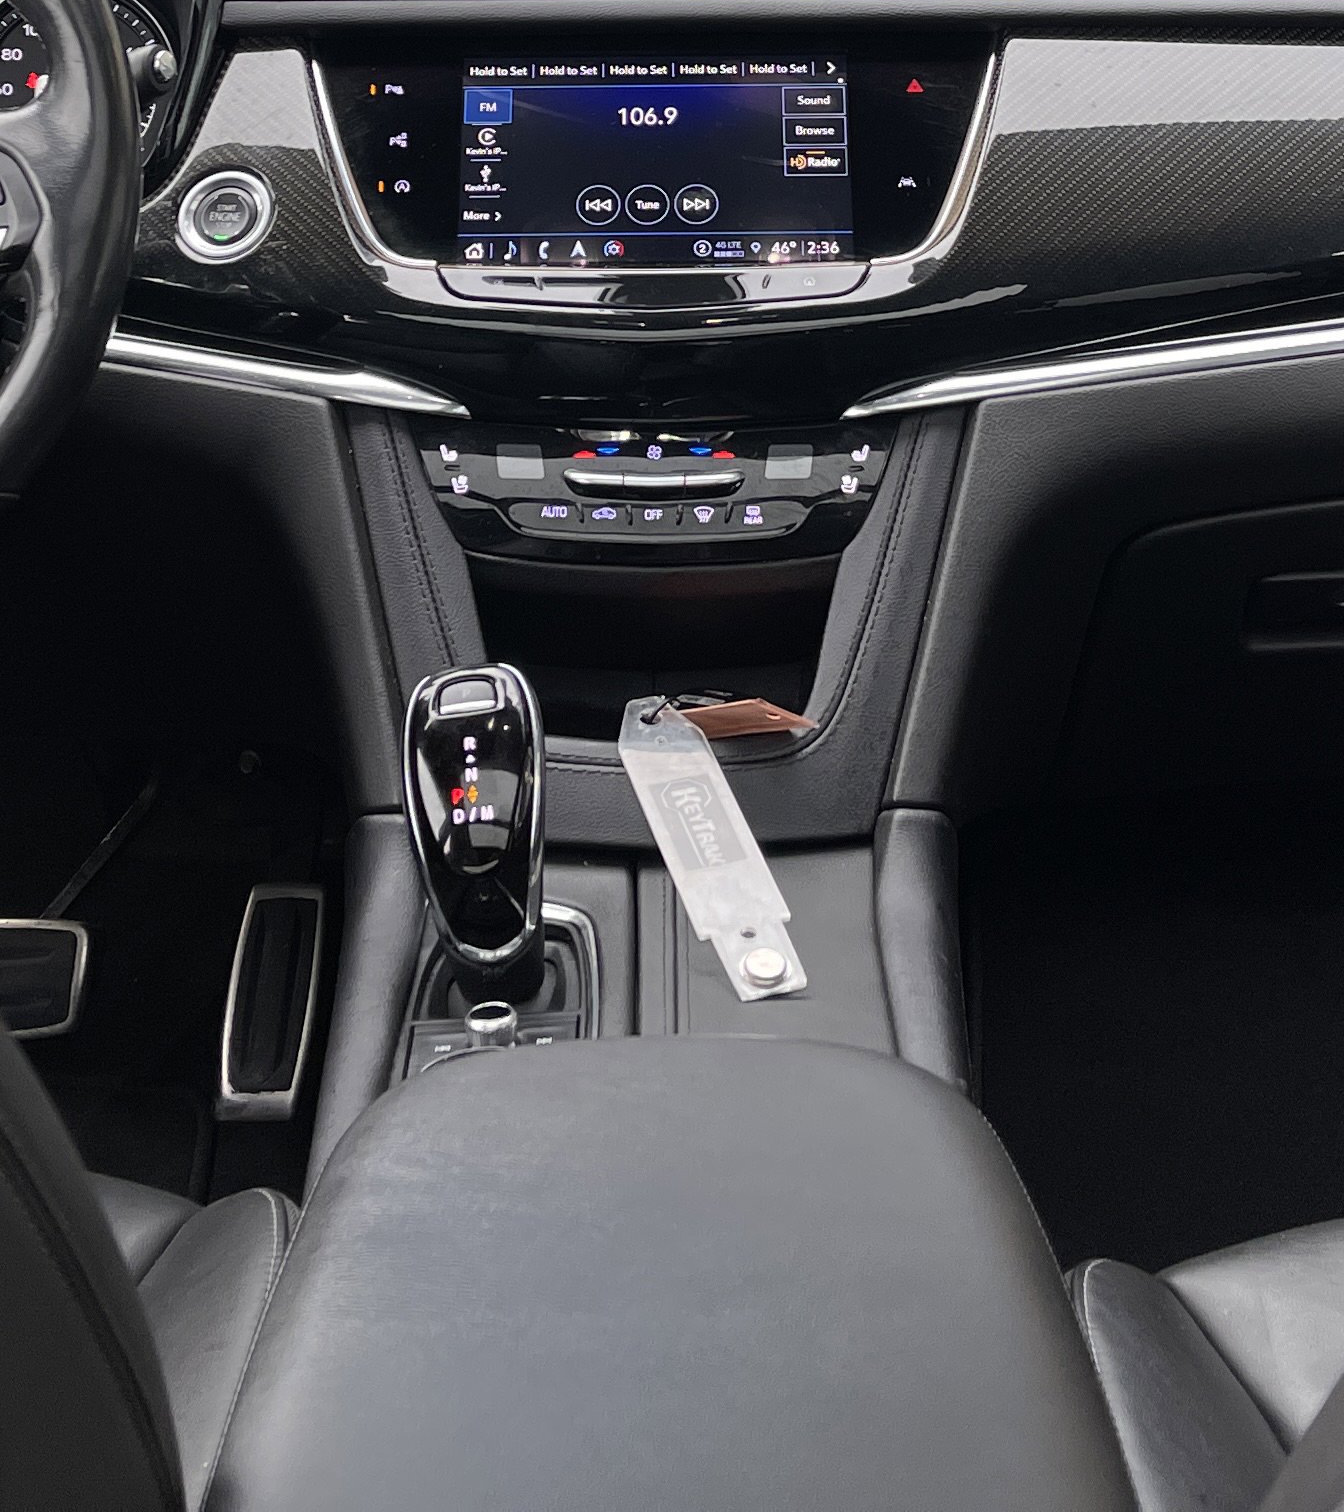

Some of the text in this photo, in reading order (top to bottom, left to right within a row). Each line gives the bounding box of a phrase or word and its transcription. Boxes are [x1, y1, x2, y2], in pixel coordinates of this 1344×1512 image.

[0, 48, 23, 62] 80
[469, 65, 528, 77] Hold to Set
[540, 64, 598, 76] Hold to Set
[609, 64, 668, 75] Hold to Set
[679, 63, 738, 74] Hold to Set
[749, 63, 808, 73] Hold to Set
[796, 95, 831, 105] Sound
[479, 102, 497, 112] FM
[617, 106, 678, 126] 106.9
[795, 125, 835, 136] Browse
[465, 147, 492, 155] Kevin's
[807, 156, 839, 168] Radio
[464, 183, 492, 192] Kevin's
[216, 203, 237, 211] START
[635, 199, 660, 211] Tune
[208, 211, 242, 222] ENGINE
[463, 210, 490, 221] More
[727, 240, 742, 249] LTE
[771, 240, 797, 254] 46°
[807, 241, 840, 254] 2:36
[541, 506, 568, 518] AUTO
[644, 508, 664, 521] OFF
[743, 516, 763, 525] REAR
[463, 736, 476, 751] R
[464, 766, 478, 783] N
